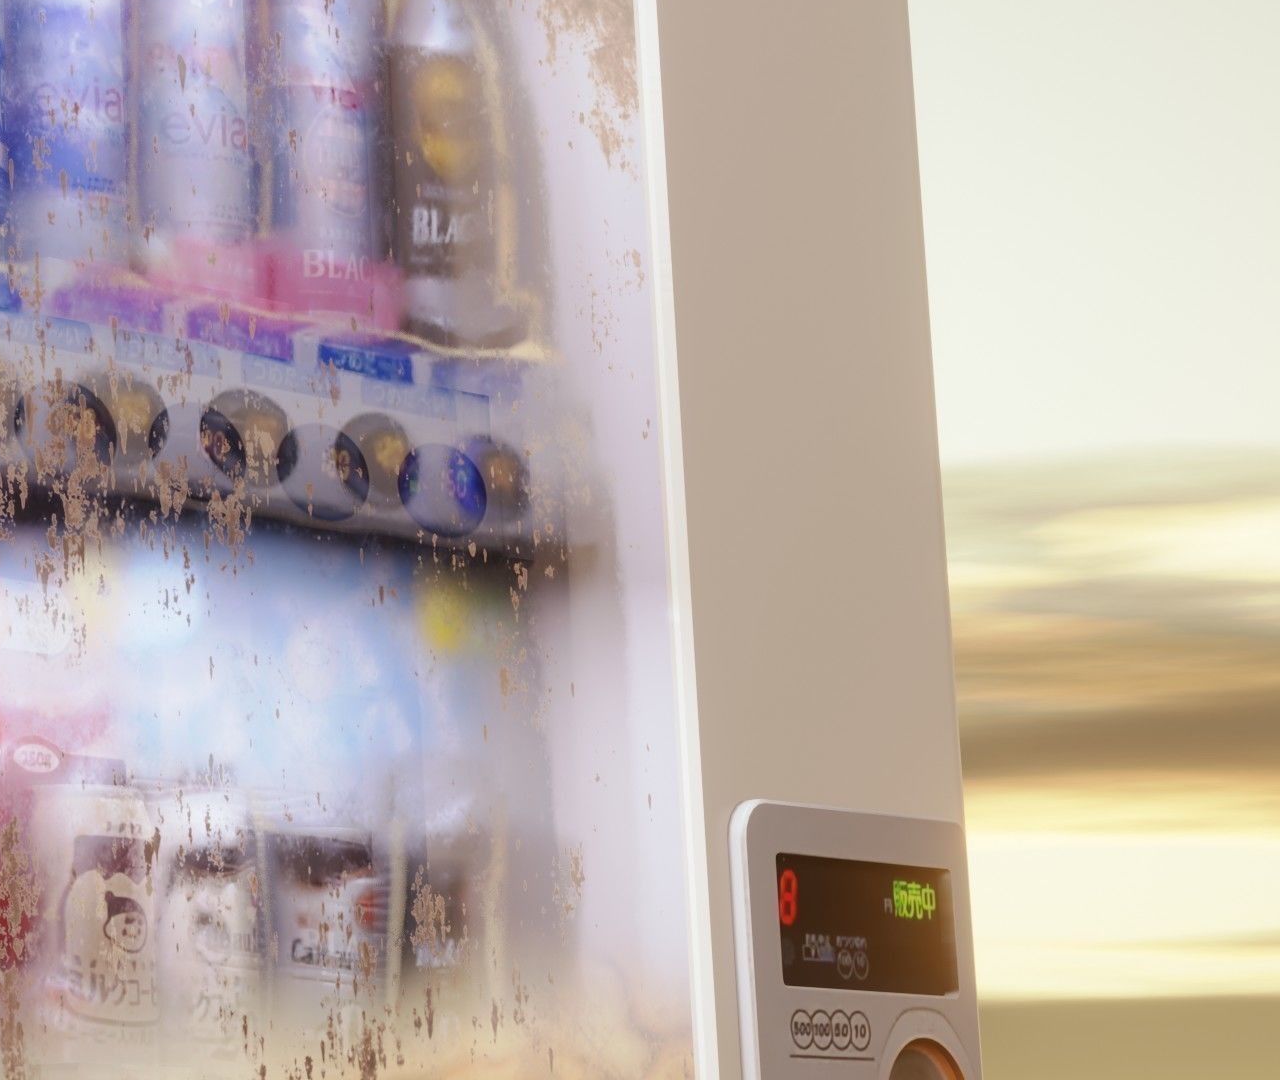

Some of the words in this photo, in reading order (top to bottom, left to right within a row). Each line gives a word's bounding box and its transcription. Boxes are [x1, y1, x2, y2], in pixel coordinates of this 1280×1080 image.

[36, 80, 123, 122] evia
[161, 109, 248, 151] evia
[412, 206, 462, 245] BLA
[892, 879, 936, 920] 販売中
[794, 1021, 811, 1037] 500
[814, 1023, 830, 1038] 100
[834, 1022, 848, 1038] 50
[854, 1024, 867, 1039] 10
